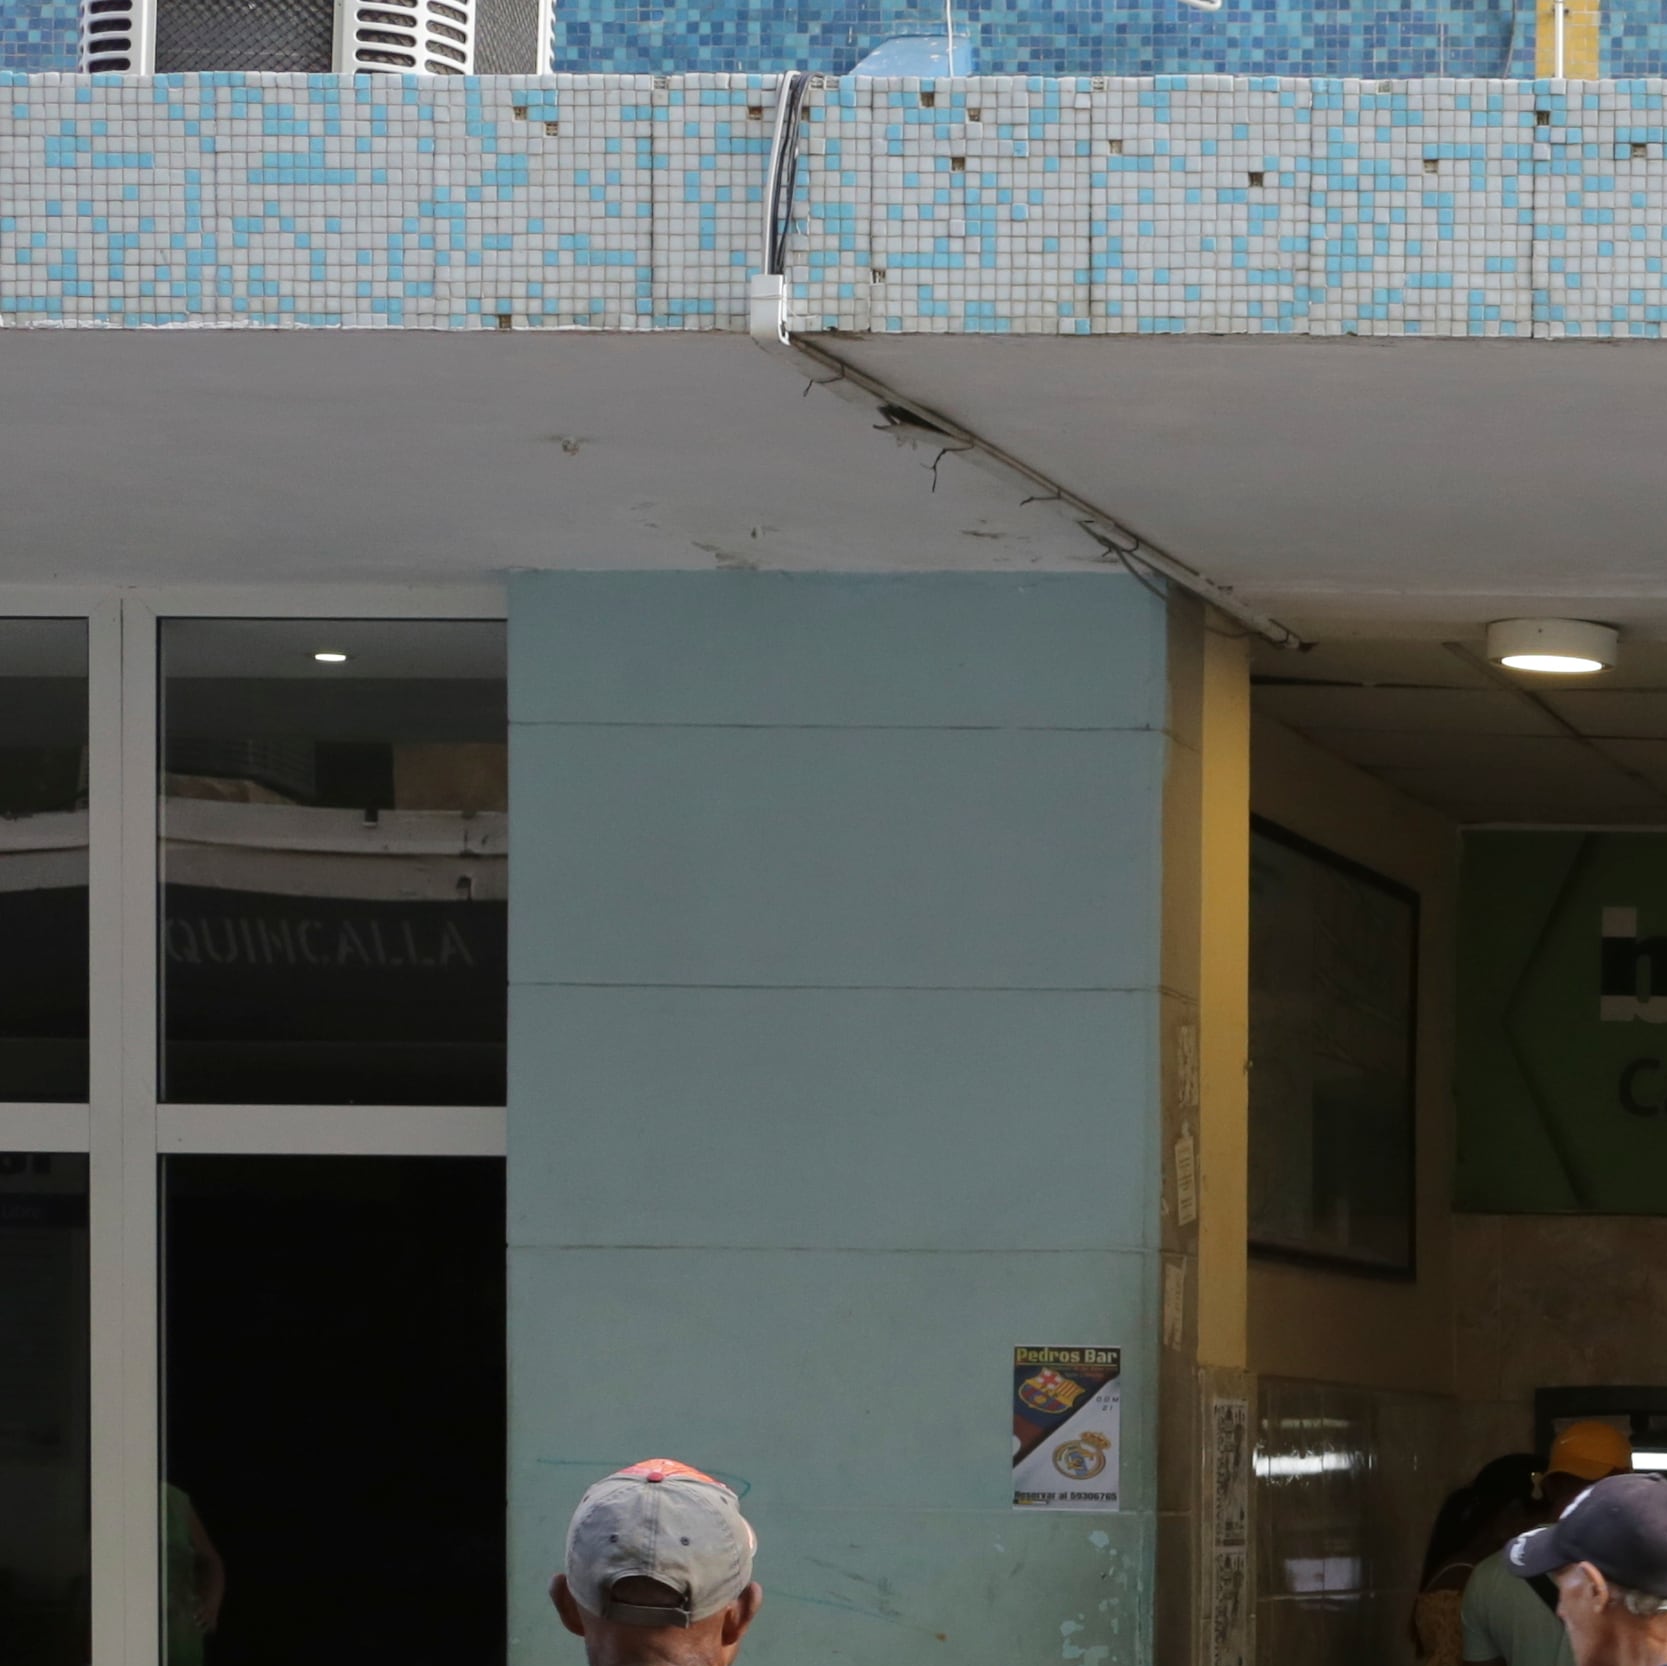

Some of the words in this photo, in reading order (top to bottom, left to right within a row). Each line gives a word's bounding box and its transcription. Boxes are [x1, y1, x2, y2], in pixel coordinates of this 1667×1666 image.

[165, 916, 476, 968] QUINCALLA
[1016, 1347, 1081, 1362] Pedros
[1084, 1349, 1118, 1363] Bar
